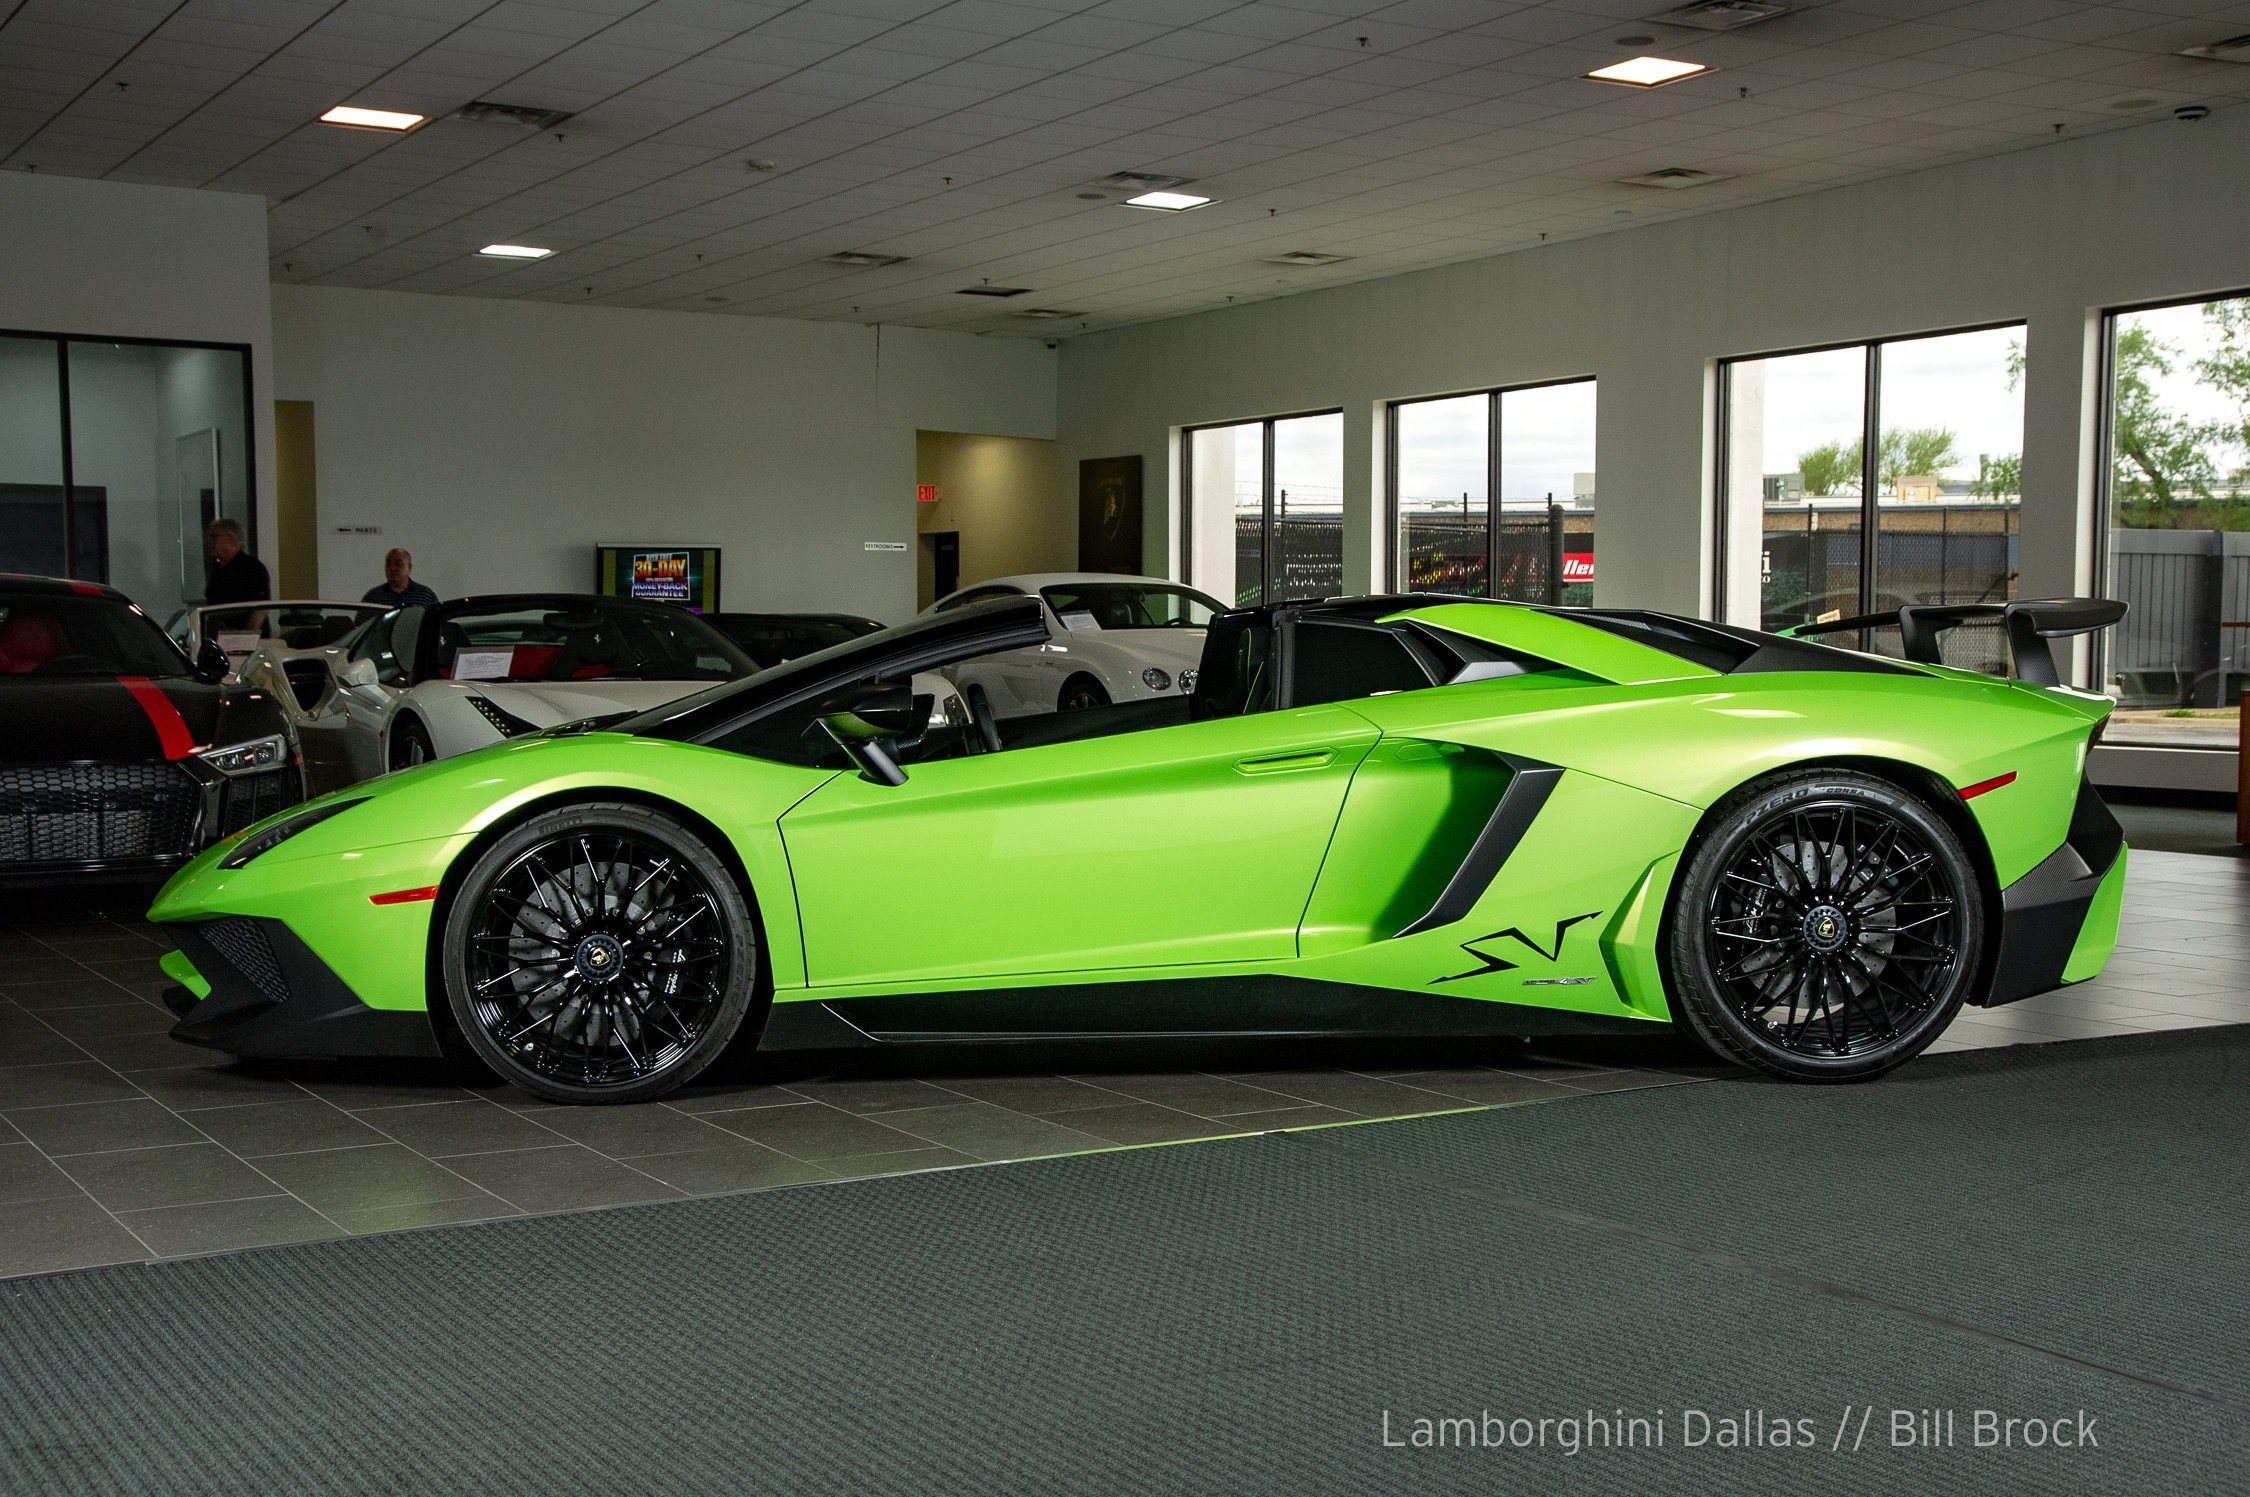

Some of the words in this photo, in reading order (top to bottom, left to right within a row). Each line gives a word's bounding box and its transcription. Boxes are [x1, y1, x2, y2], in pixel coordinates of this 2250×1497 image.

[918, 485, 935, 501] EXIT
[635, 559, 686, 577] 30-DAY
[633, 582, 688, 591] MONEY-BACK
[1826, 787, 1866, 797] CORSA
